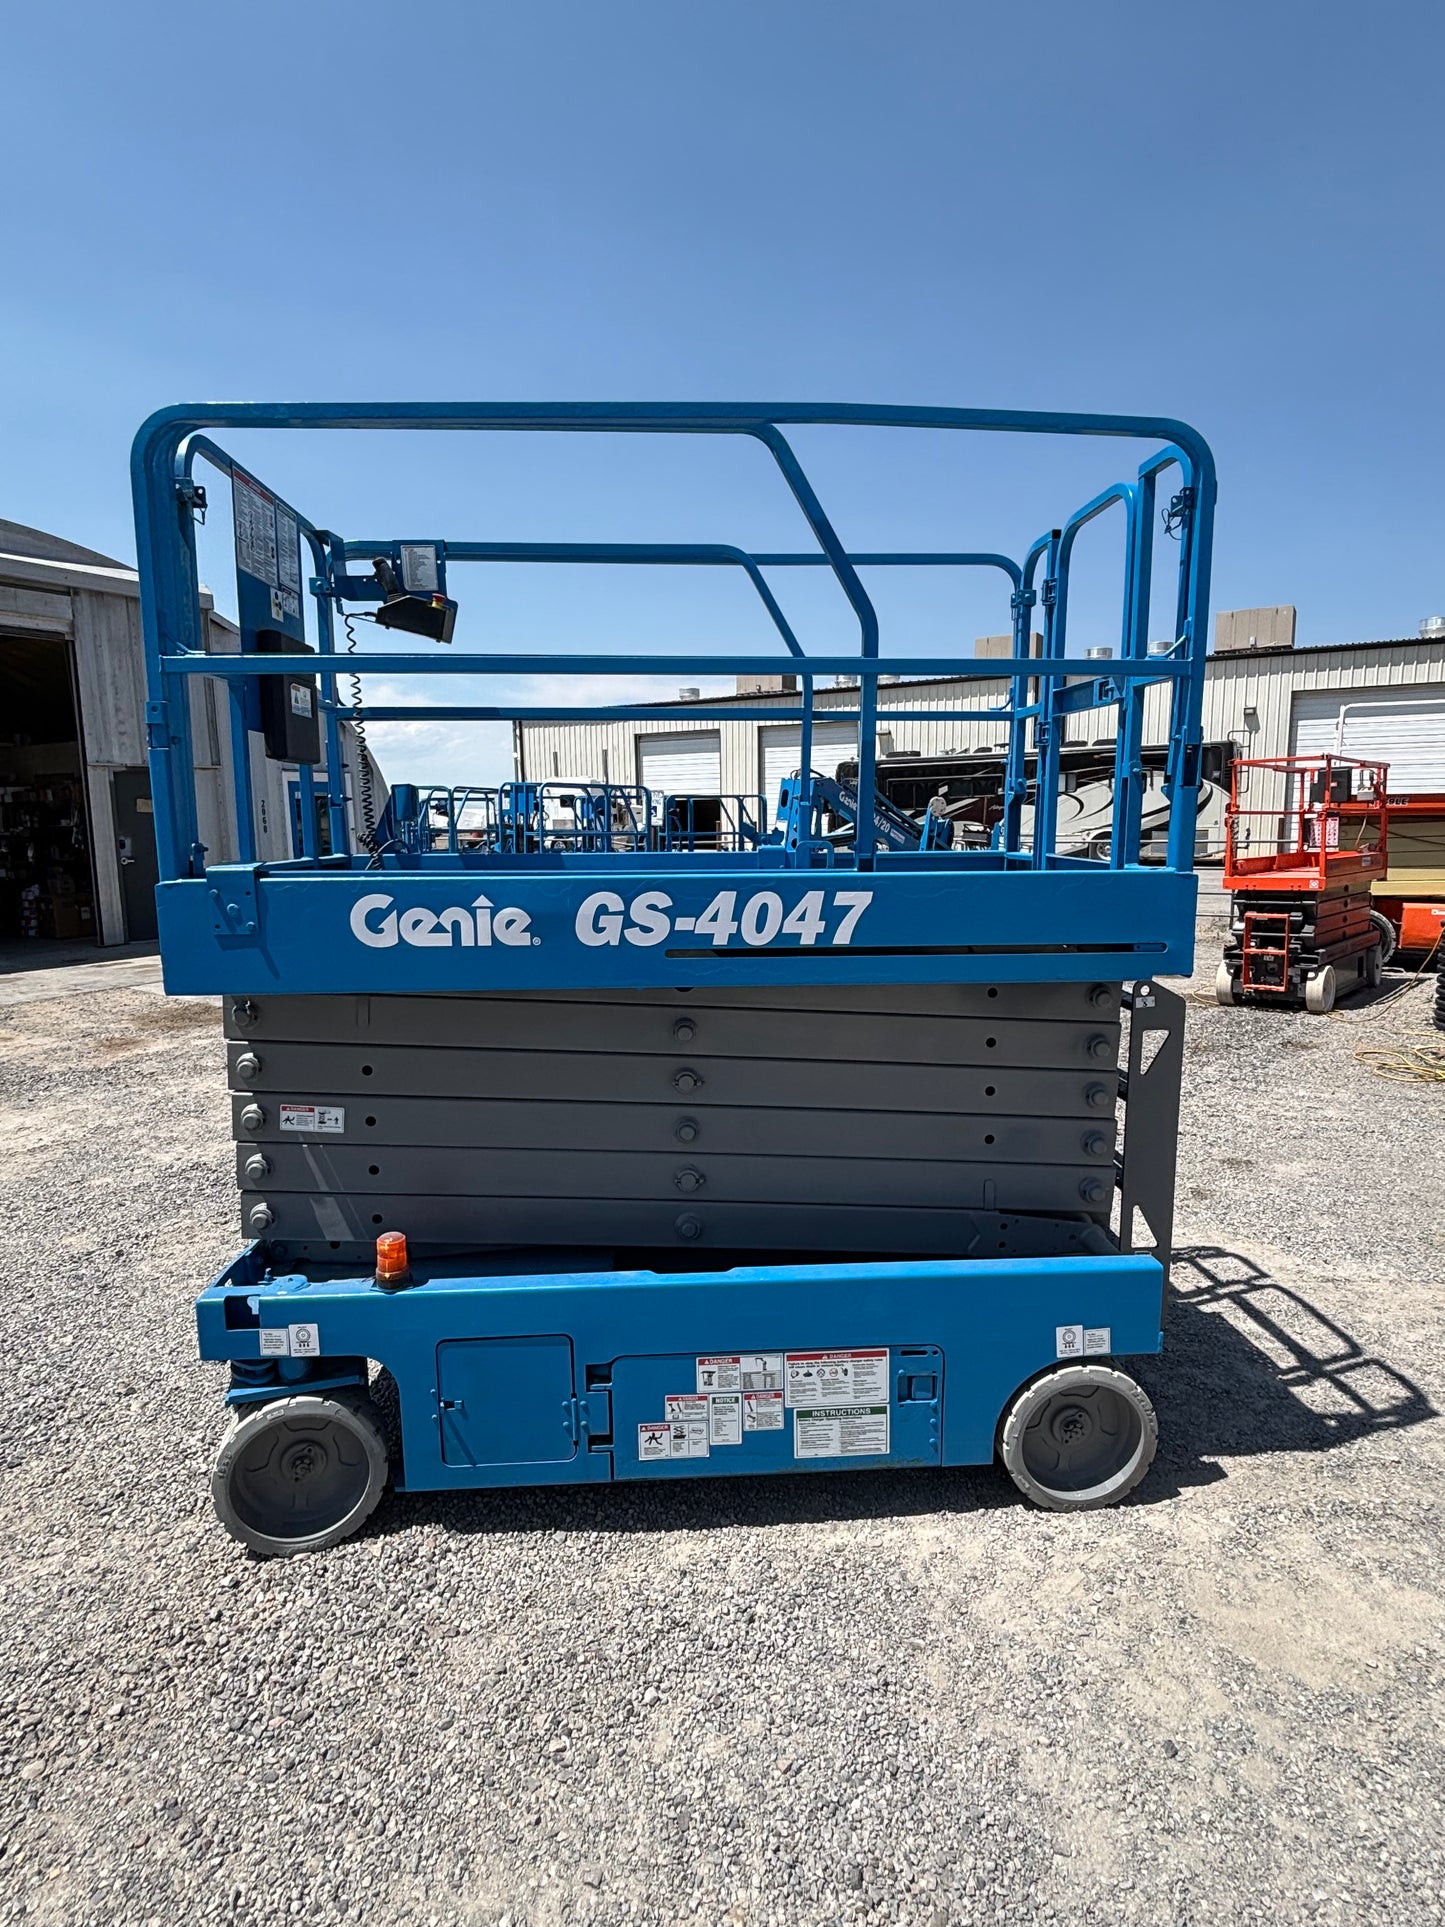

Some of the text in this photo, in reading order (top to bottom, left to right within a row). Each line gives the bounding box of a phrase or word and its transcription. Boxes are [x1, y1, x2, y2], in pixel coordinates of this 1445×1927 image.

[349, 891, 874, 949] Genie GS-4047
[812, 1407, 871, 1417] INSTRUCTIONS
